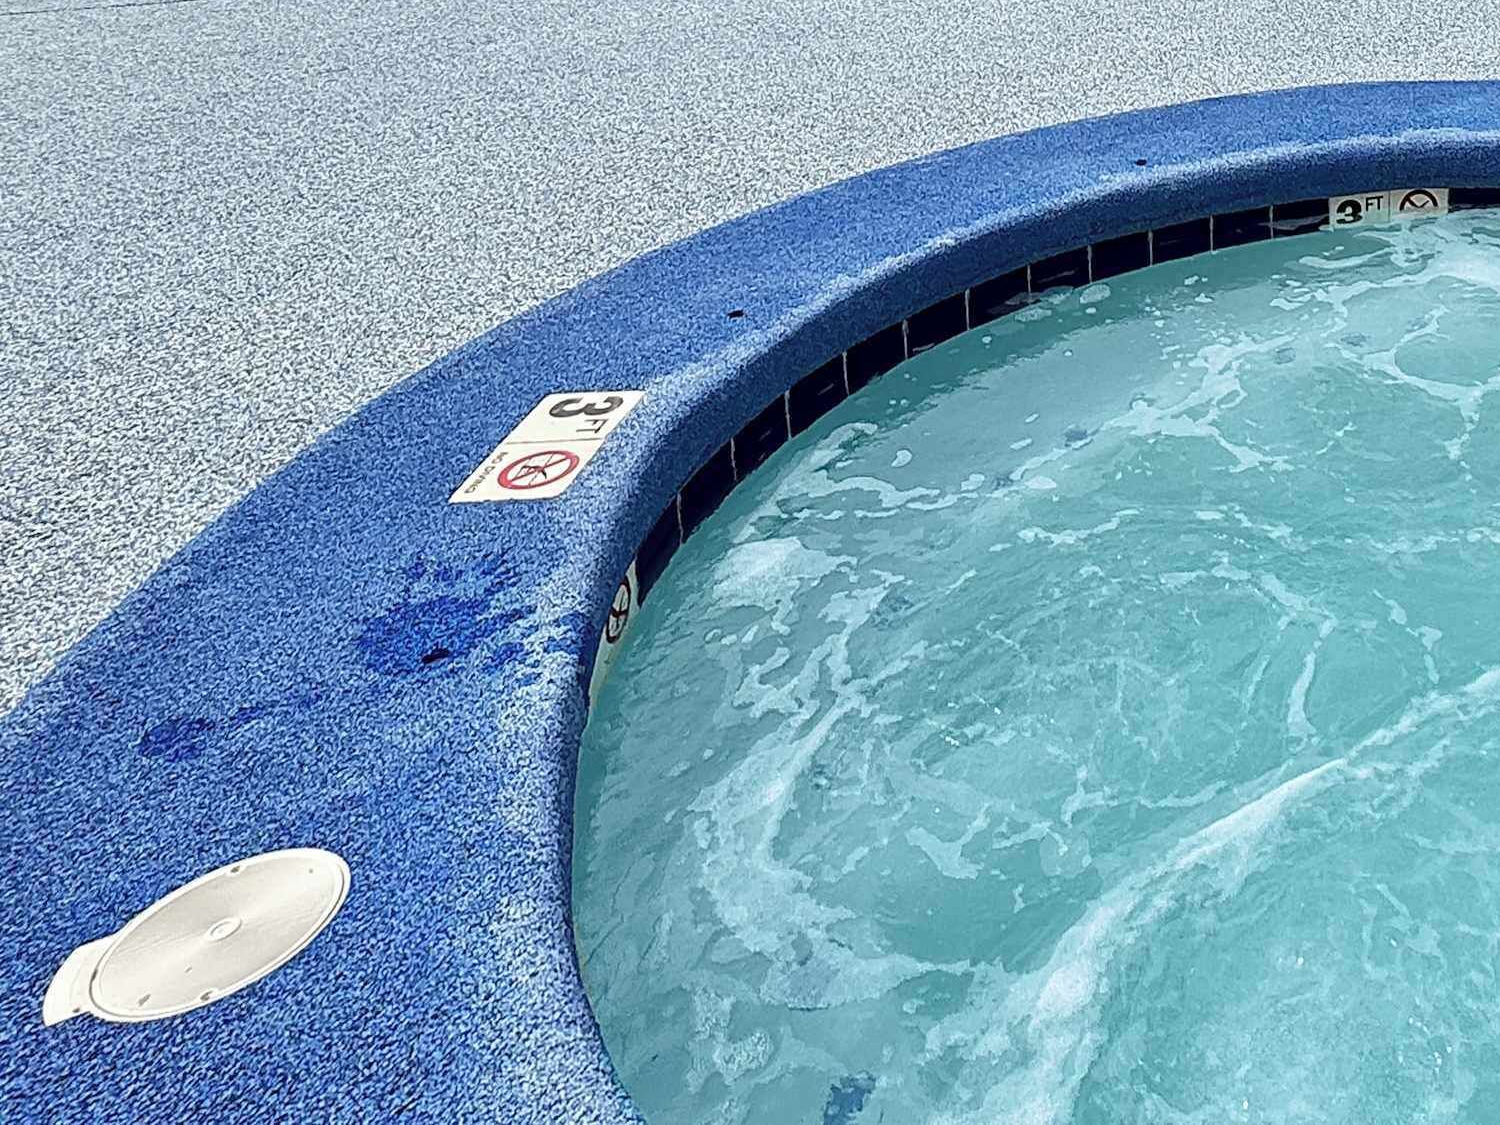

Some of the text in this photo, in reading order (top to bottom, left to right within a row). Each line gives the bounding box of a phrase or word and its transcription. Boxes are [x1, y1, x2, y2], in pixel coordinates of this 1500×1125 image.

[1335, 195, 1384, 225] 3 FT
[548, 395, 624, 434] 3 FT
